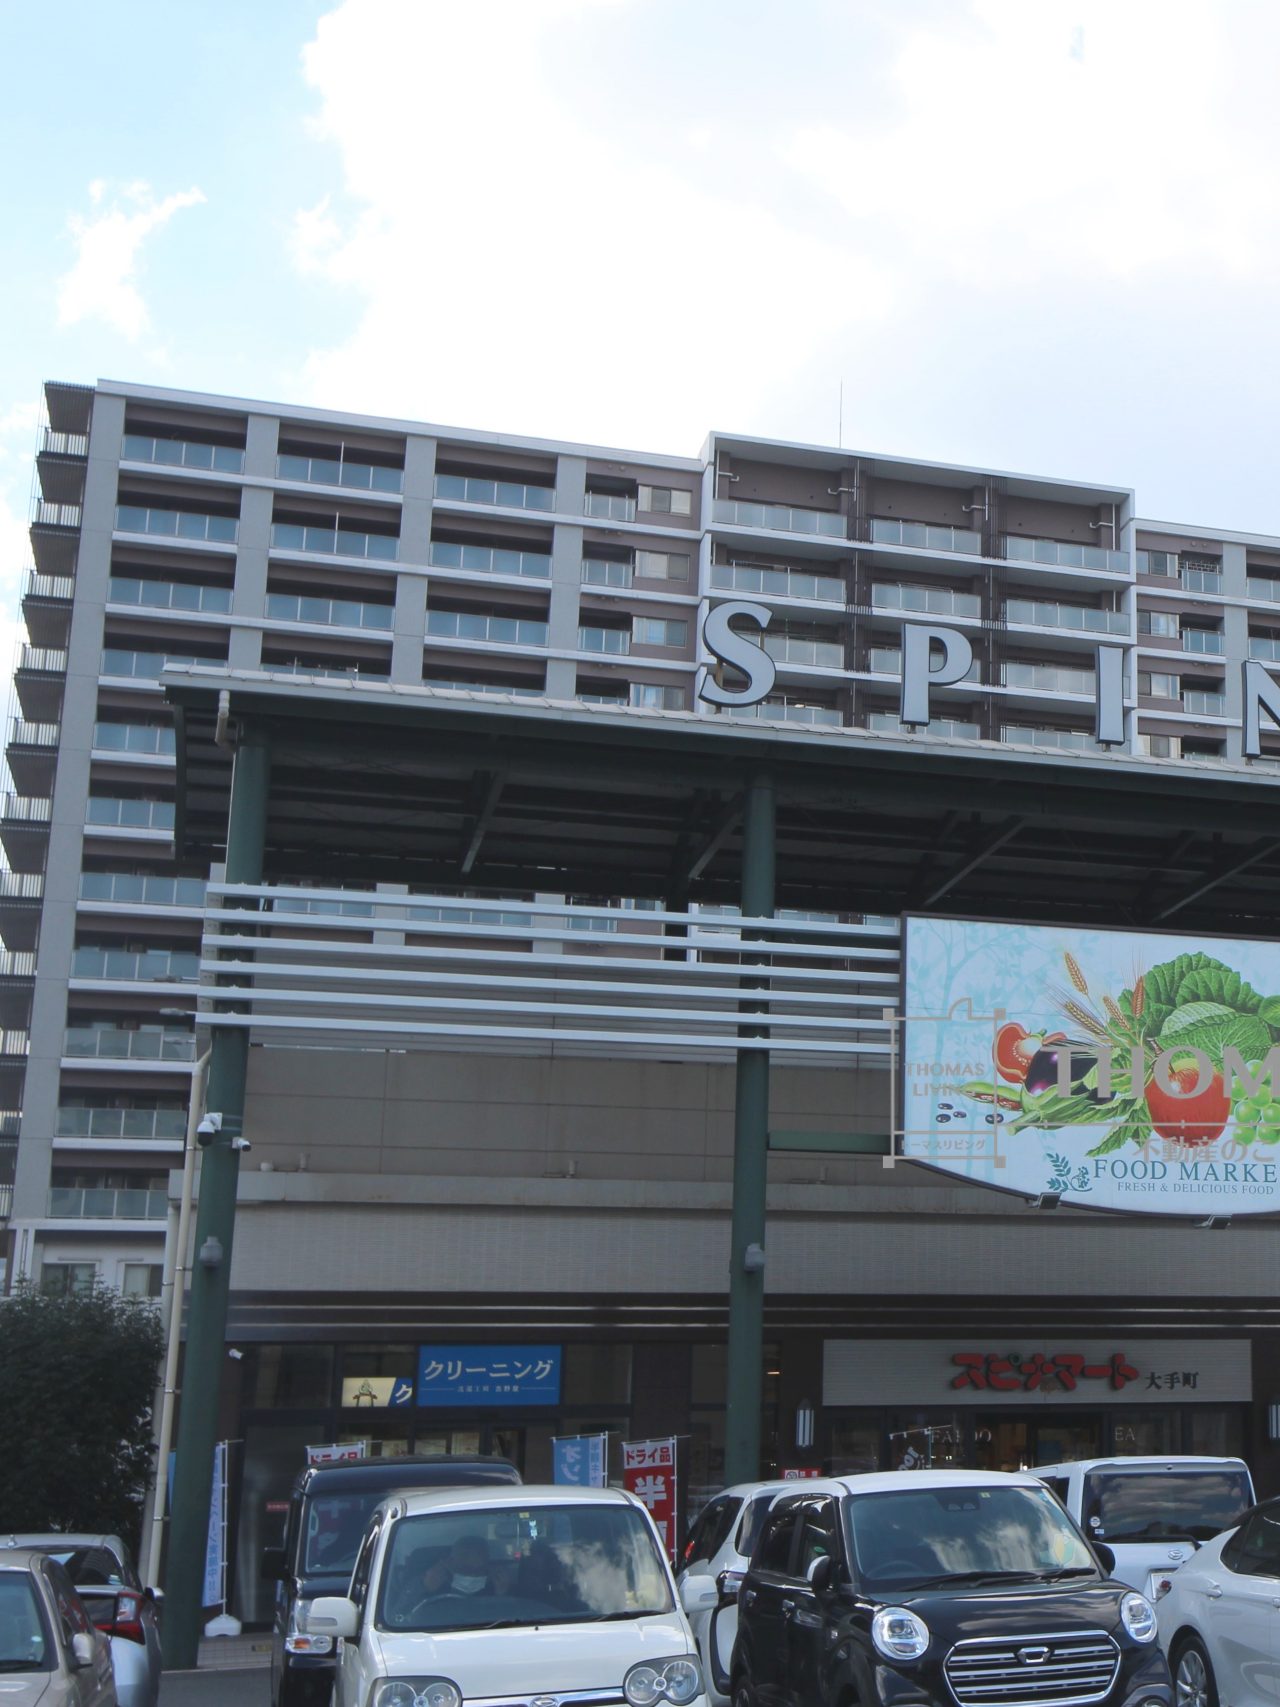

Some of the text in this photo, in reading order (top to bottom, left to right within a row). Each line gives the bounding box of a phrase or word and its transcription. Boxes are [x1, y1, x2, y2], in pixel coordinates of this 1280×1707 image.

[1094, 1159, 1168, 1180] FOOD
[1117, 1181, 1274, 1195] FRESH & DELICIOUS FOOD
[424, 1360, 553, 1380] クリーニング
[952, 1353, 1199, 1390] スピナマート 大手町
[626, 1447, 671, 1466] ドライ品
